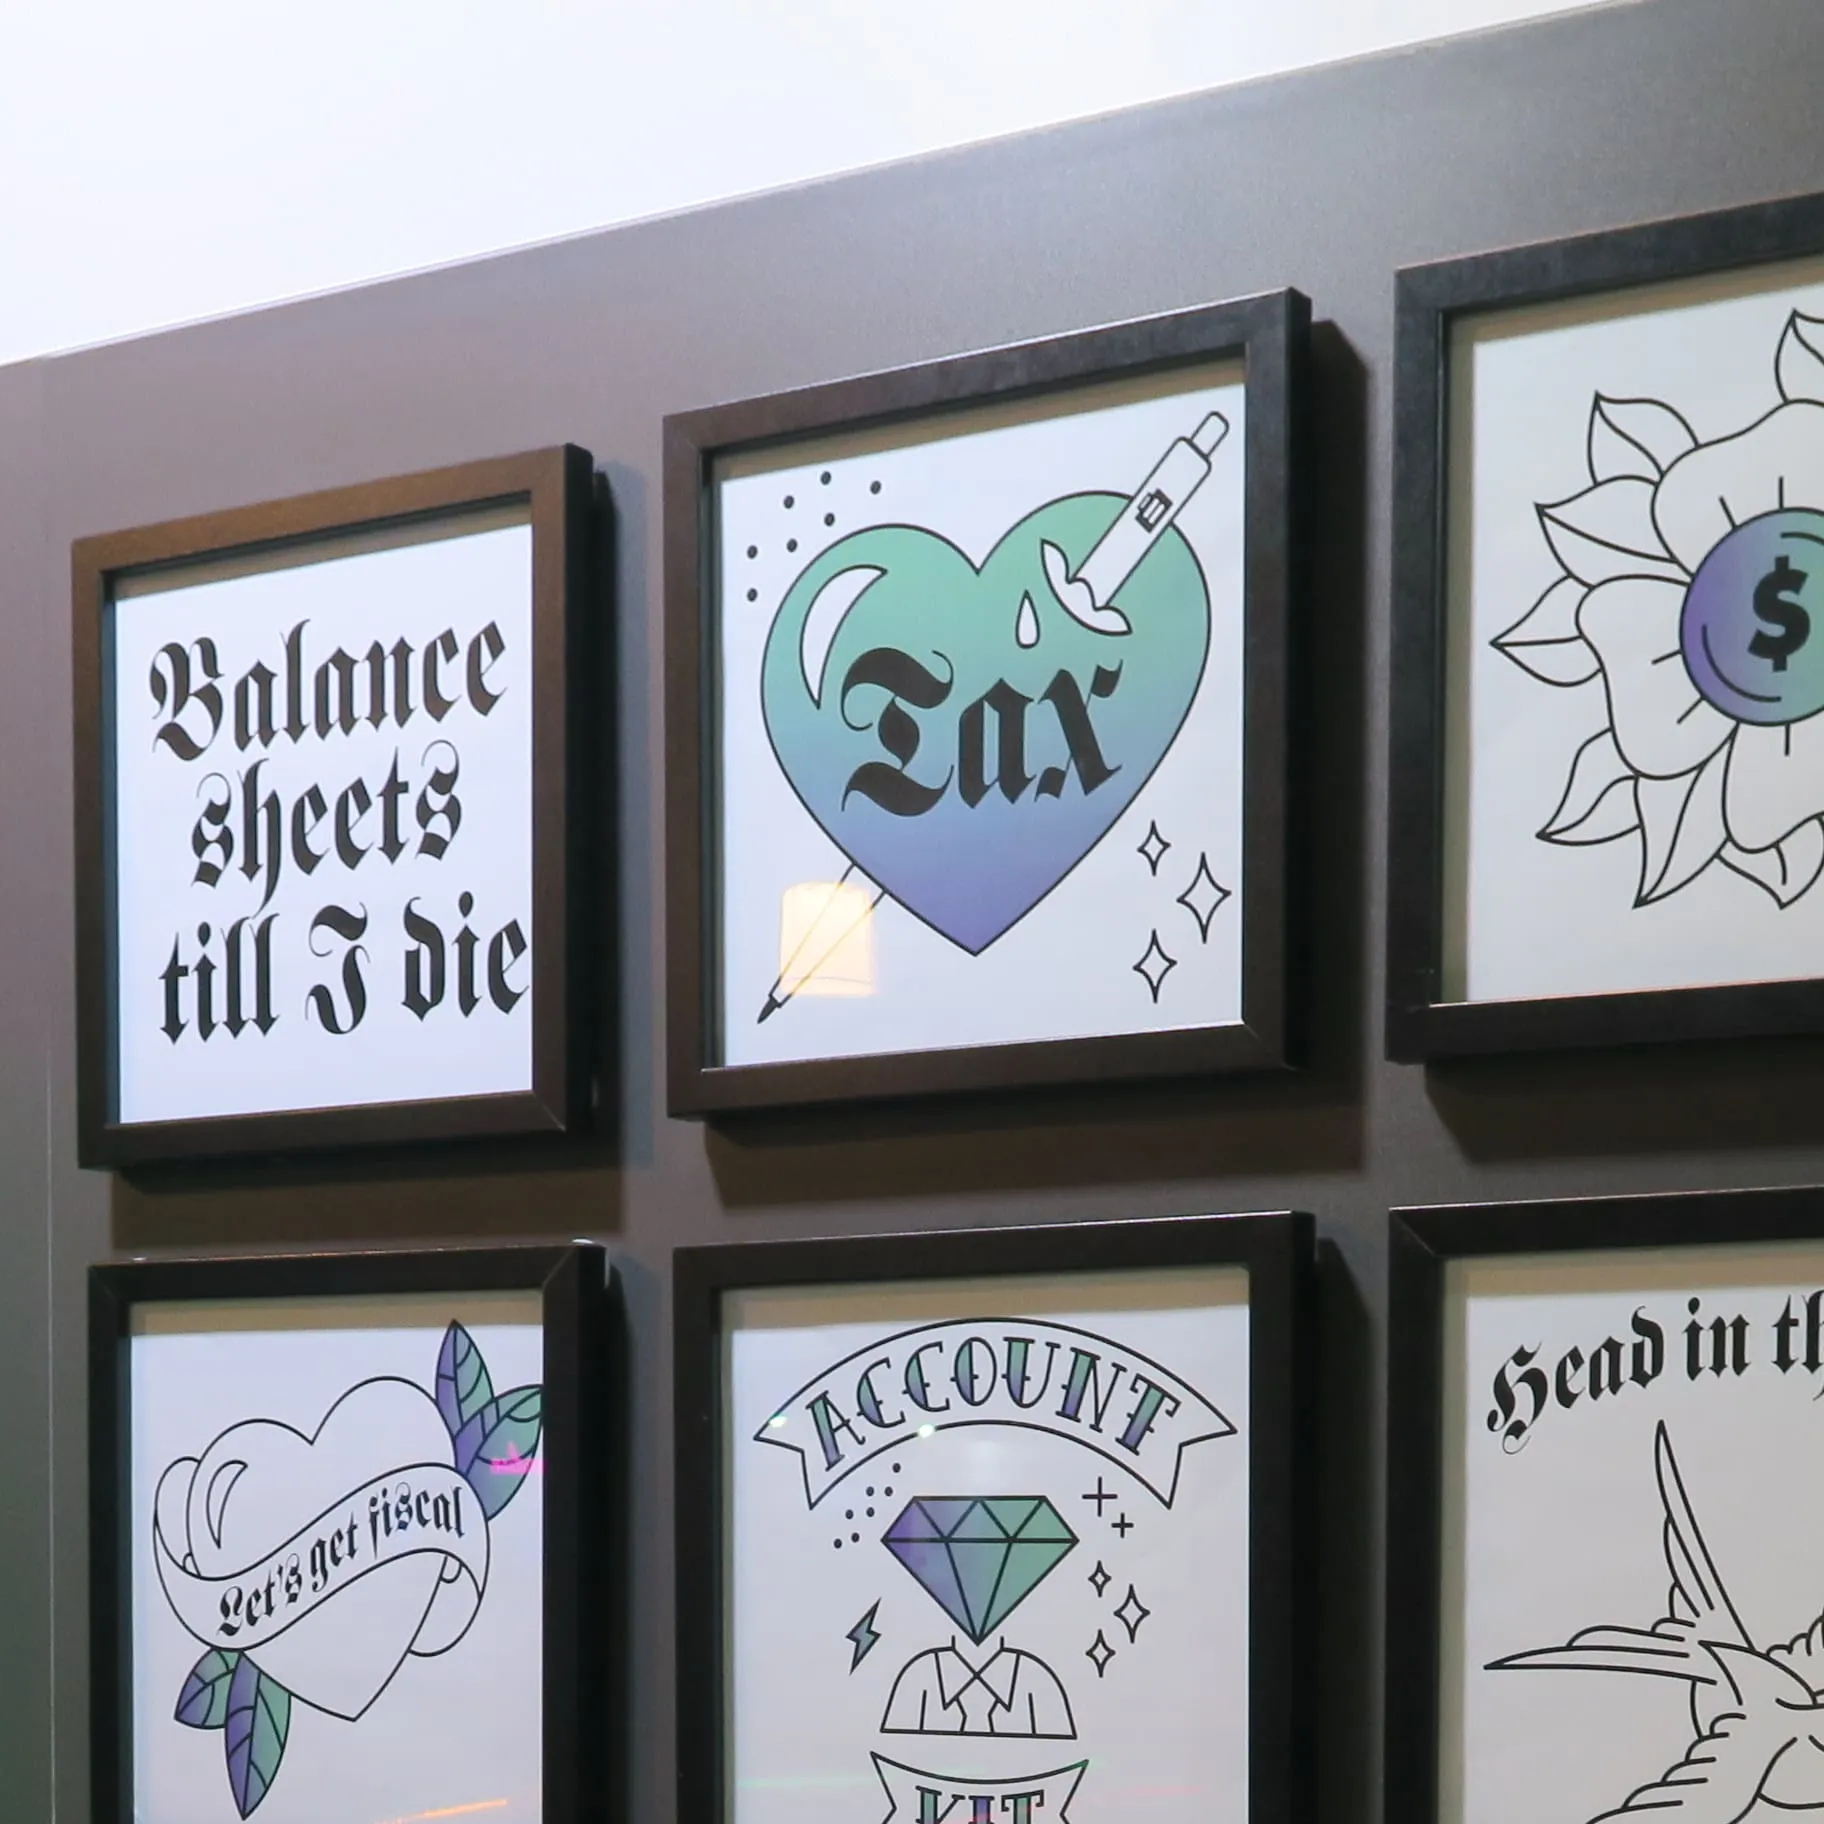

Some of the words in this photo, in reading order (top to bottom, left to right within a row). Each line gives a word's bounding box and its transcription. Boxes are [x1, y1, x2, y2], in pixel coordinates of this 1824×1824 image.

[149, 618, 508, 762] Balance
[839, 646, 1124, 818] Tax
[191, 739, 463, 920] sheets
[158, 913, 281, 1045] till
[305, 901, 371, 1035] I
[401, 890, 530, 1022] die
[805, 1335, 1182, 1473] ACCOUNT
[1486, 1305, 1666, 1456] Head
[1682, 1296, 1752, 1382] in
[215, 1552, 304, 1637] Let's
[308, 1512, 362, 1591] get
[369, 1481, 465, 1559] fiscal
